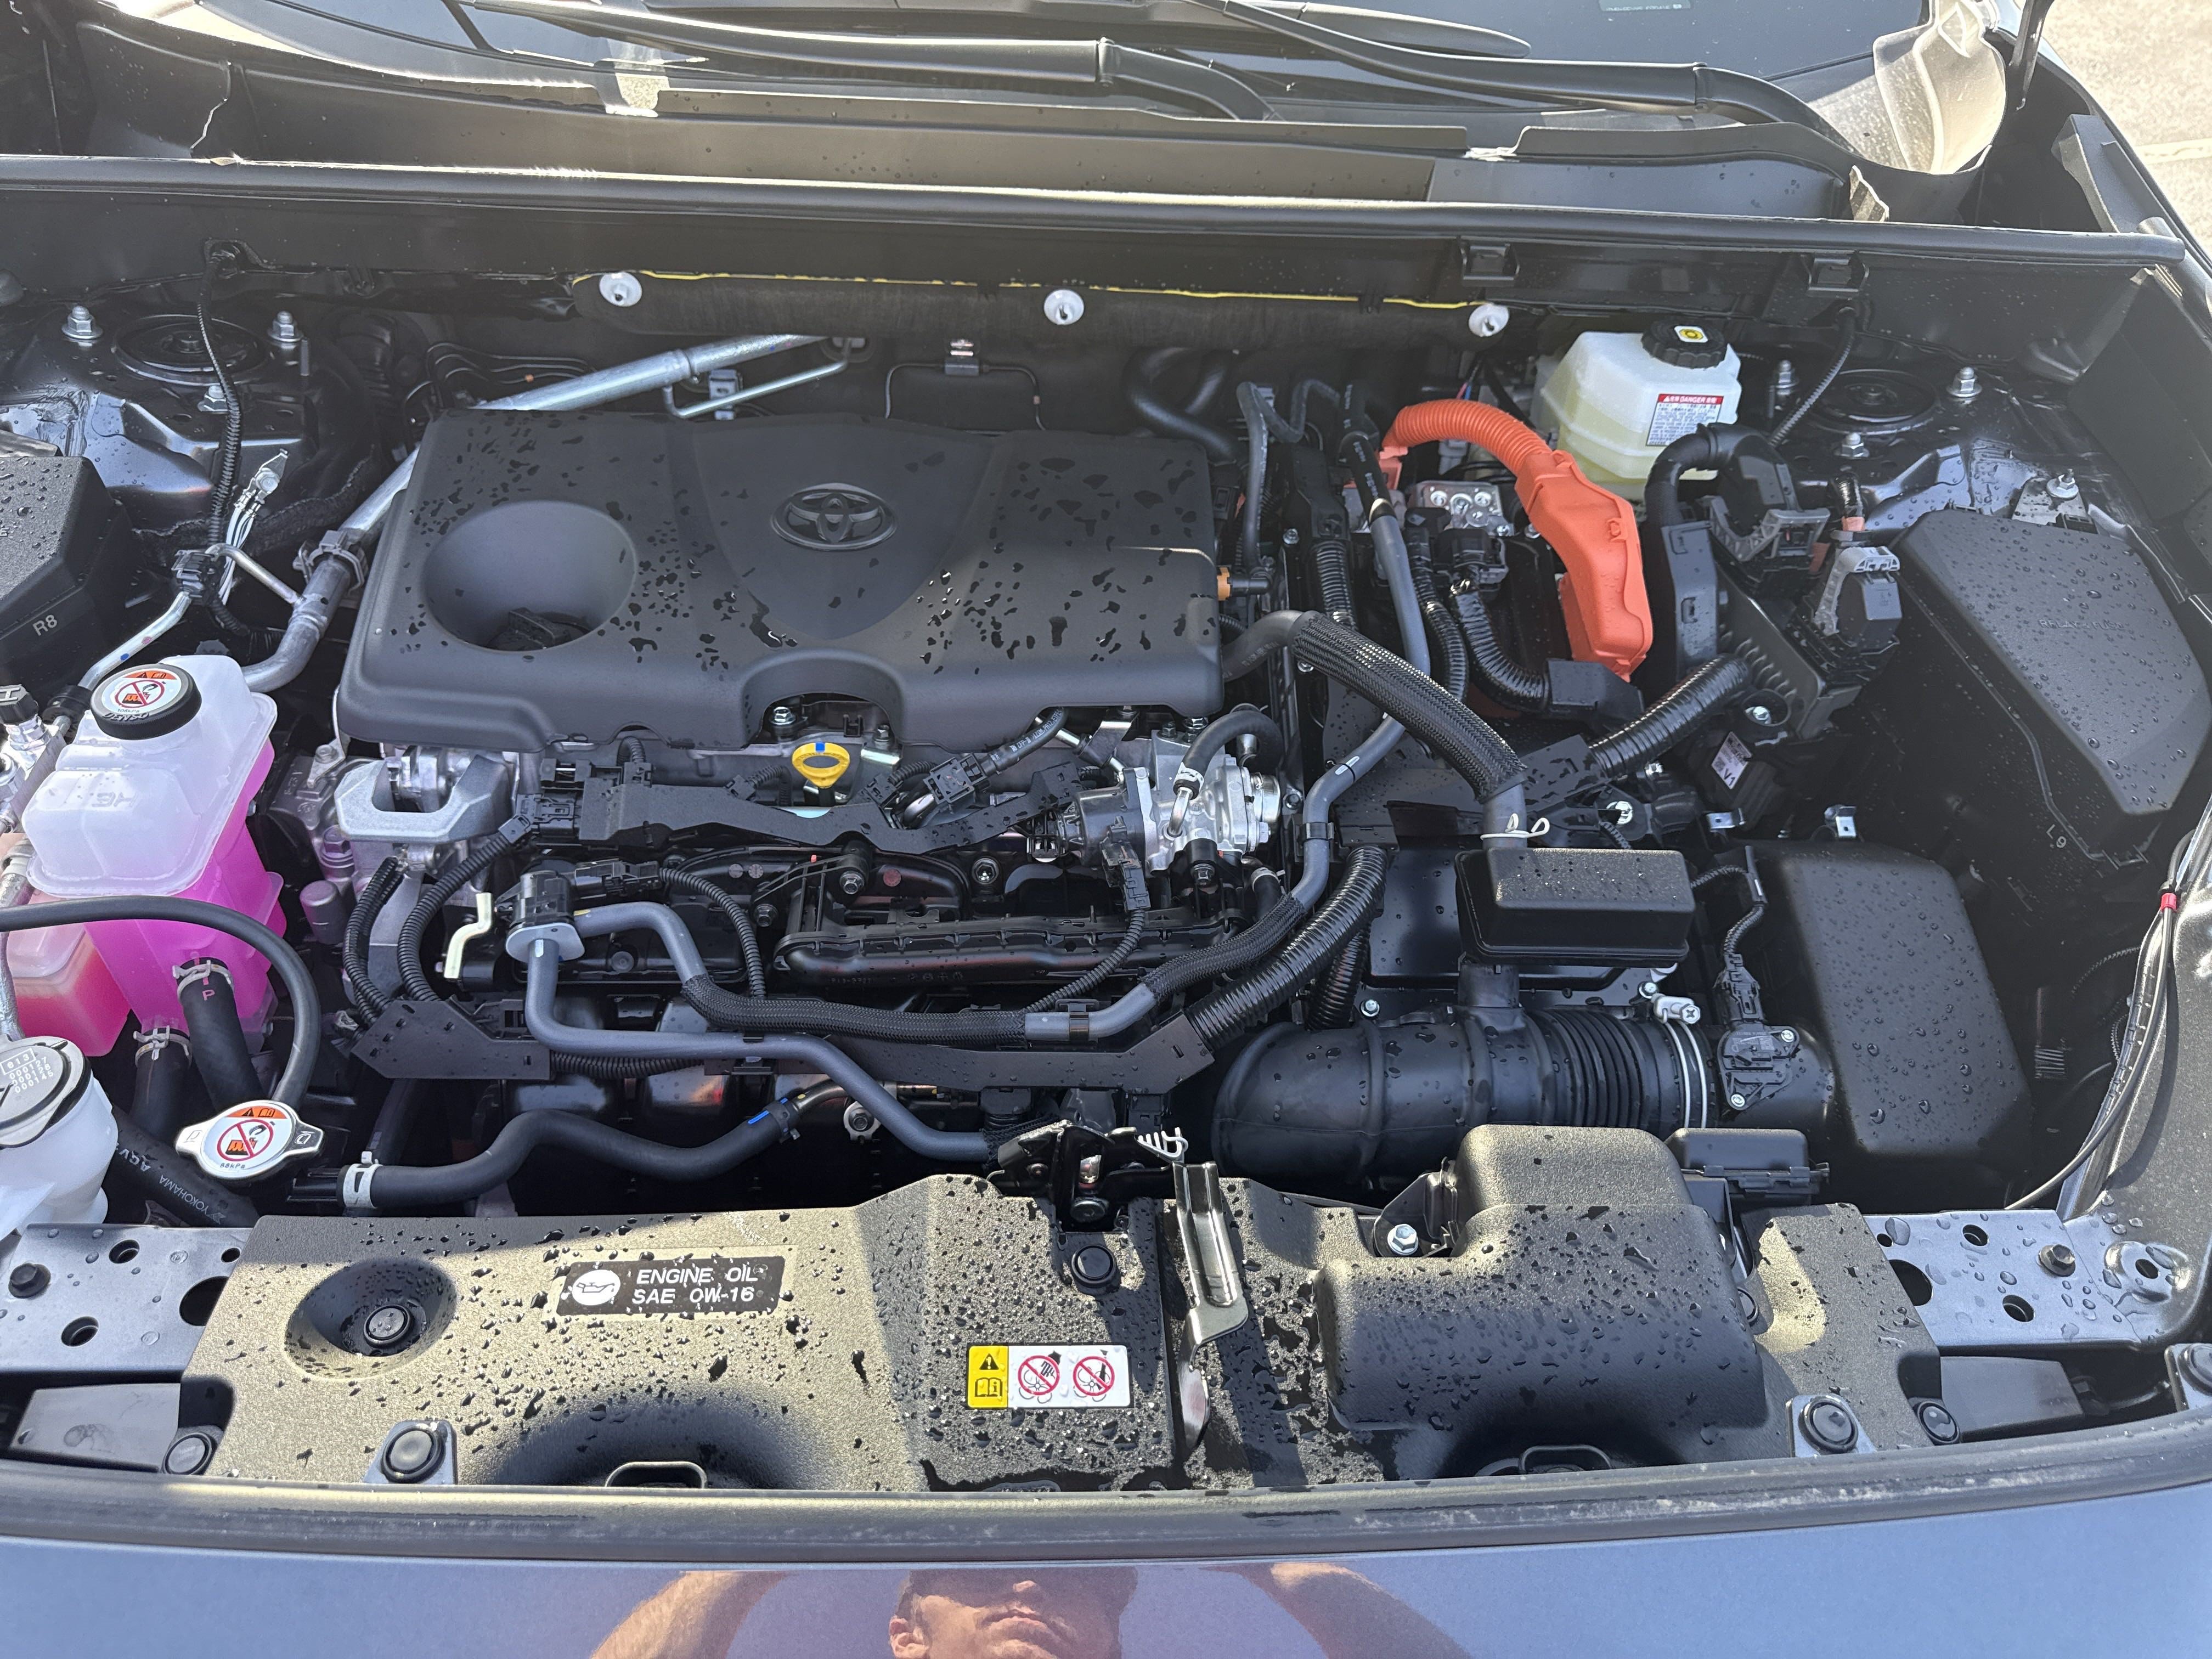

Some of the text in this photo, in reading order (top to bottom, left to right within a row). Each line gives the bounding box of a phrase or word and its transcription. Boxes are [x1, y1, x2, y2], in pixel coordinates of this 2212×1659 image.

[32, 614, 57, 636] R8
[103, 712, 150, 722] DENSO
[1724, 768, 1736, 786] V1
[202, 989, 216, 1001] P
[9, 1056, 47, 1080] 000127
[12, 1063, 51, 1086] 000128
[15, 1070, 54, 1093] 000145
[159, 1175, 208, 1214] YOKOHAMA
[636, 1267, 758, 1284] ENGINE OIL
[631, 1288, 676, 1304] SAE
